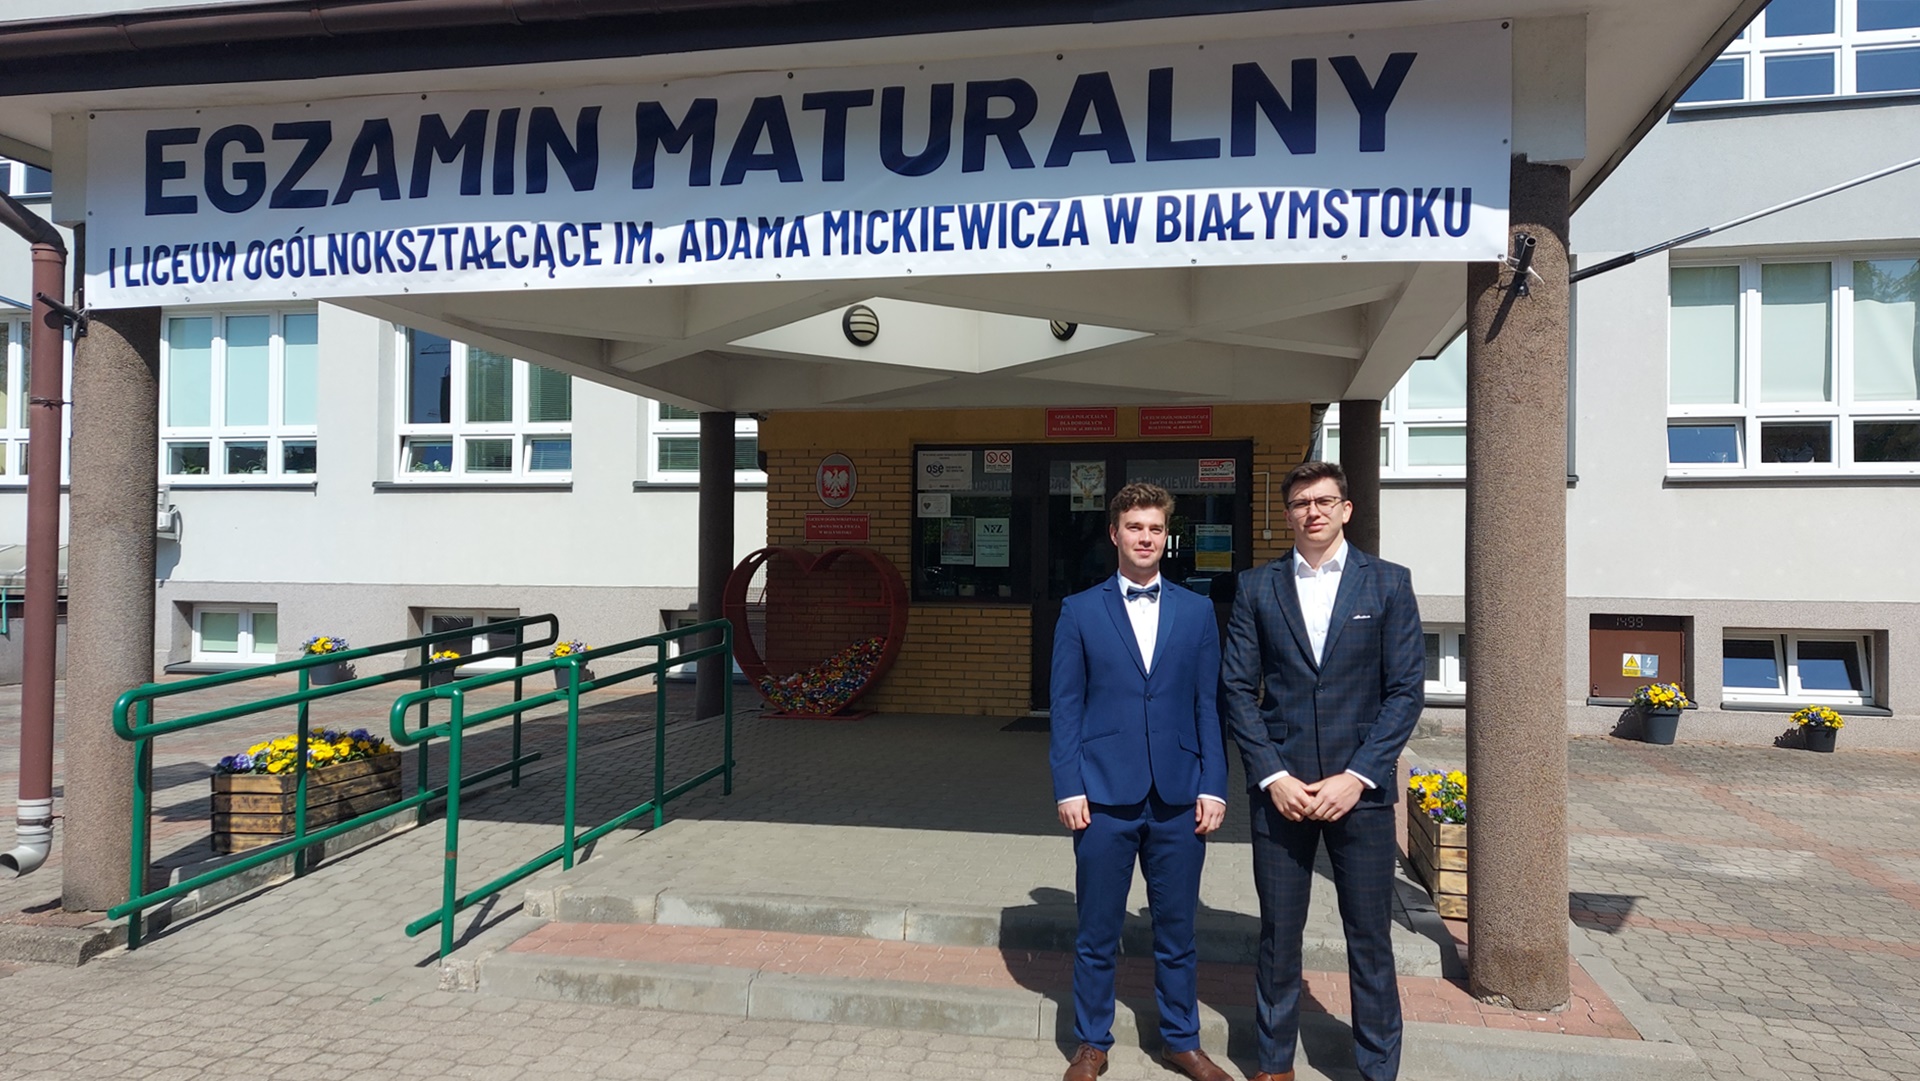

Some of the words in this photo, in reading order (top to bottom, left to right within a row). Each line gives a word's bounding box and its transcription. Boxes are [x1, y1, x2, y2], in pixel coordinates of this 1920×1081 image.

[144, 107, 601, 216] EGZAMIN
[632, 52, 1417, 190] MATURALNY
[108, 247, 117, 289] I
[124, 241, 236, 288] LICEUM
[243, 221, 602, 281] OGÓLNOKSZTAŁCĄCE
[613, 221, 665, 265] IM.
[678, 216, 810, 262] ADAMA
[822, 200, 1089, 257] MICKIEWICZA
[1102, 197, 1145, 245] W
[1155, 187, 1473, 243] BIAŁYMSTOKU
[983, 524, 1003, 533] NFZ
